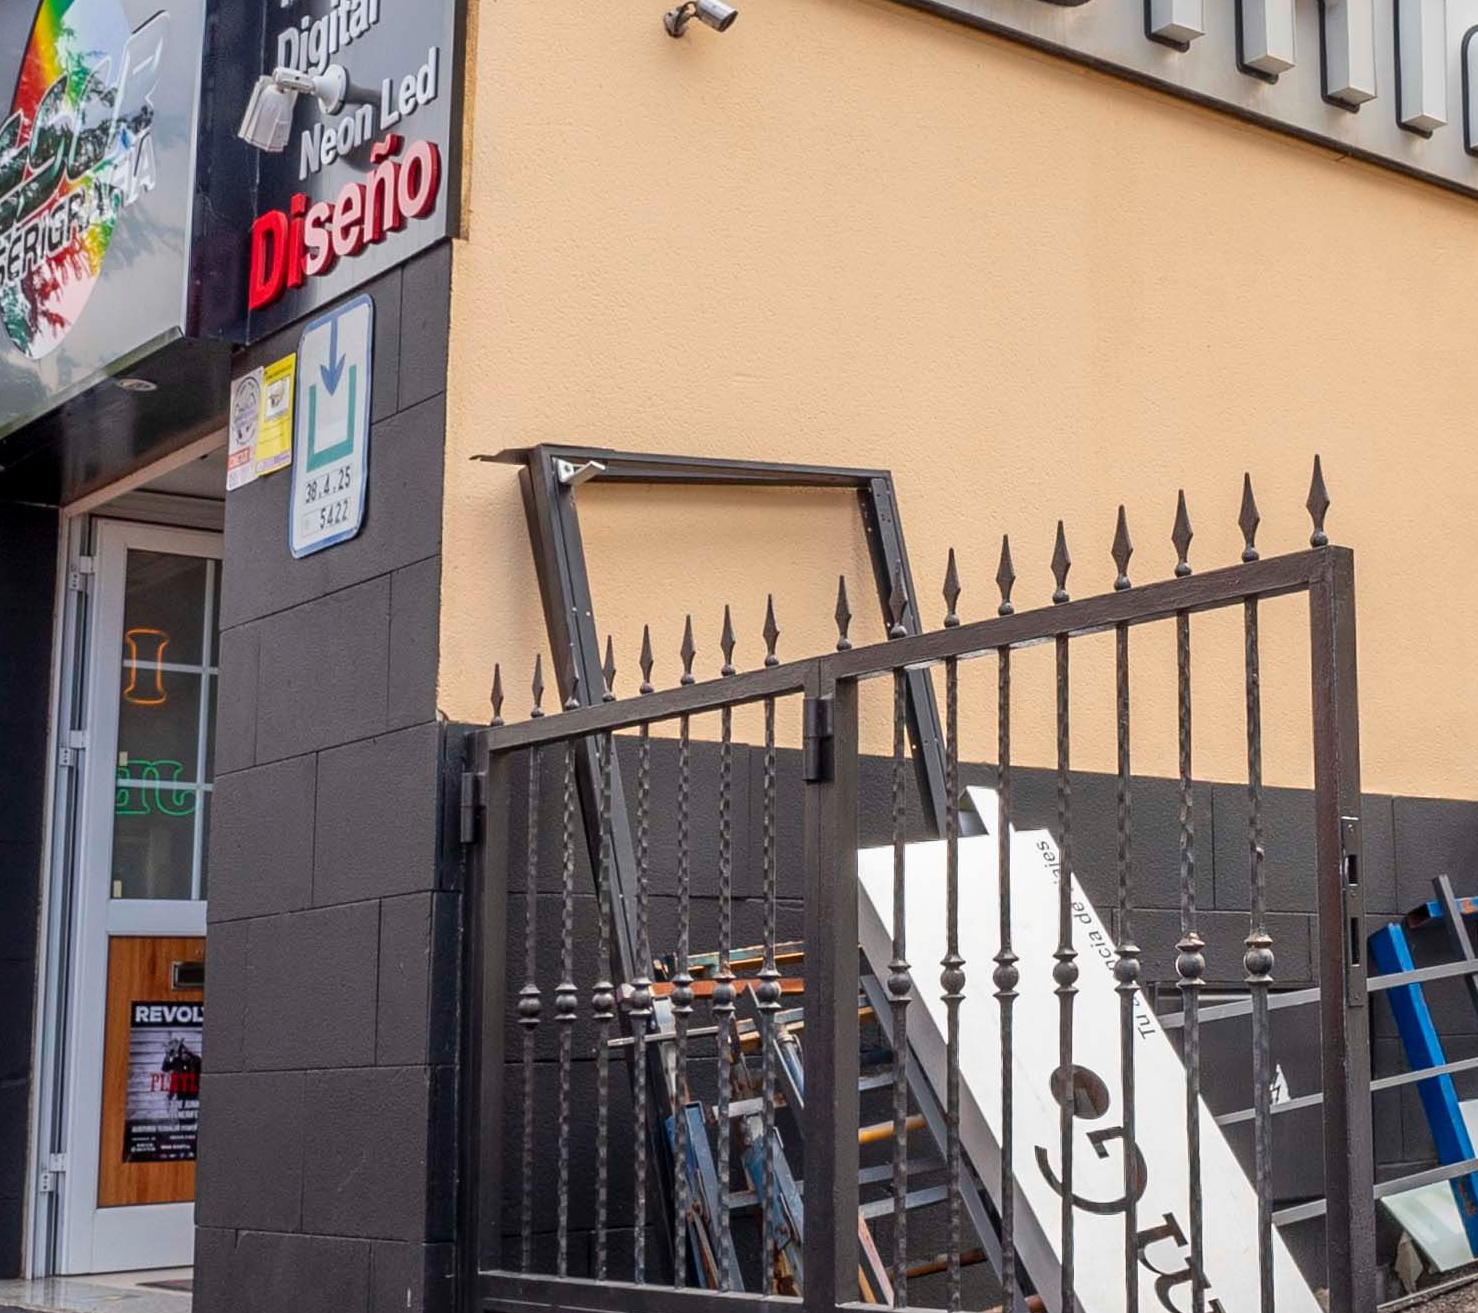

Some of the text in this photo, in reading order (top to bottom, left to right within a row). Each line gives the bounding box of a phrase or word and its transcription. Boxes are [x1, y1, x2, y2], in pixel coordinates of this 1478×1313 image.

[299, 46, 440, 181] Neon Led
[249, 133, 442, 312] Diseño
[320, 498, 349, 530] 5422
